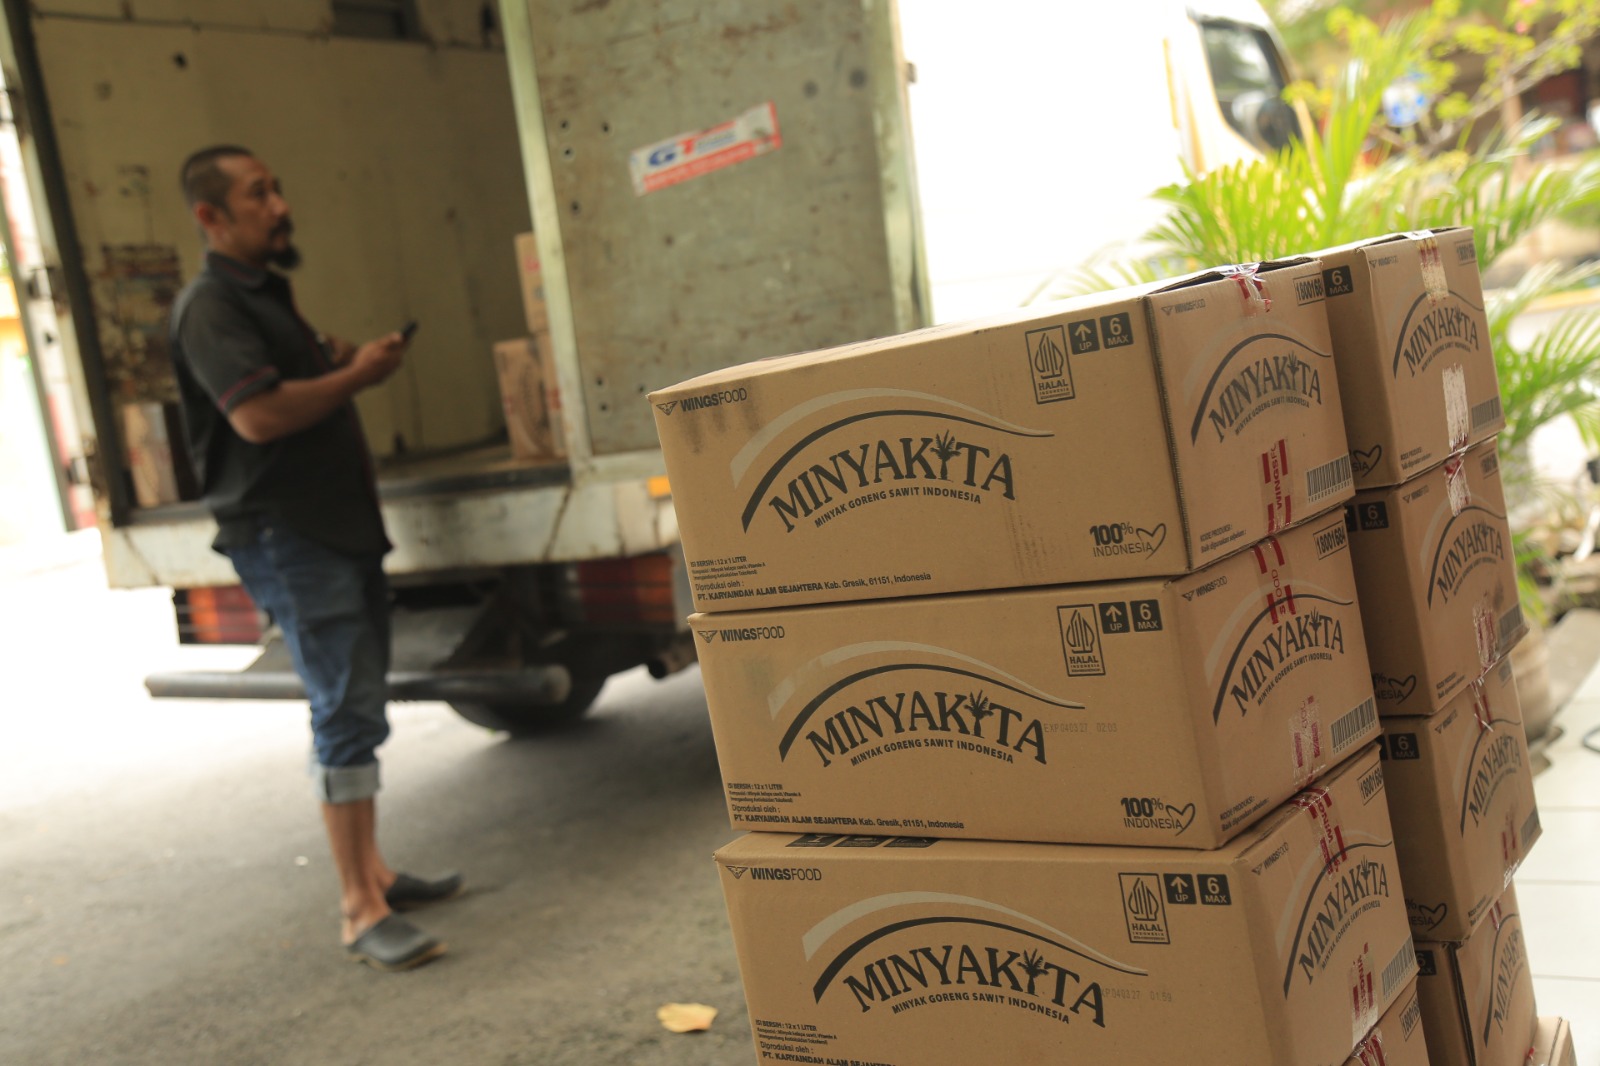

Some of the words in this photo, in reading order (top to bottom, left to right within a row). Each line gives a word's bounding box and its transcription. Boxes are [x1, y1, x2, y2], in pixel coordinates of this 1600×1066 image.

[1331, 270, 1343, 285] 6
[1329, 284, 1350, 294] MAX
[1109, 317, 1122, 336] 6
[1079, 341, 1092, 351] UP
[1107, 334, 1129, 346] MAX
[1038, 379, 1069, 391] HALAL
[680, 387, 747, 412] WINGSFOOD
[769, 430, 1016, 533] MINYAKITA
[814, 503, 848, 528] MINYAK
[848, 491, 887, 510] GORENG
[888, 486, 920, 498] SAWIT
[922, 486, 982, 504] INDONESIA
[1367, 505, 1379, 520] 6
[1364, 519, 1385, 528] MAX
[1089, 521, 1135, 546] 100%
[1093, 542, 1154, 557] INDONESIA
[732, 556, 747, 564] LITER
[695, 581, 726, 592] Diproduksi
[727, 580, 741, 588] oleh
[697, 593, 707, 601] PT.
[708, 588, 755, 600] KARYAINDAH
[756, 586, 777, 596] ALAM
[778, 582, 823, 594] SEJAHTERA
[824, 581, 841, 590] Kab.
[894, 572, 932, 583] Indonesia
[1140, 603, 1151, 620] 6
[1110, 623, 1123, 632] UP
[1137, 621, 1159, 630] MAX
[720, 625, 785, 642] WINGSFOOD
[1069, 655, 1099, 664] HALAL
[1230, 606, 1344, 717] MINYAKITA
[806, 689, 1047, 768] MINYAKITA
[1398, 735, 1409, 751] 6
[850, 747, 883, 767] MINYAK
[884, 739, 922, 753] GORENG
[924, 738, 954, 748] SAWIT
[957, 741, 1014, 764] INDONESIA
[732, 804, 762, 813] Diproduksi
[1121, 797, 1164, 818] 100%
[734, 814, 744, 822] PT.
[745, 814, 790, 824] KARYAINDAH
[791, 816, 813, 824] ALAM
[814, 816, 858, 826] SEJAHTERA
[858, 818, 876, 826] Kab.
[928, 820, 965, 829] Indonesia
[1123, 817, 1183, 829] INDONESIA
[750, 867, 822, 881] WINGSFOOD
[1206, 877, 1220, 894] 6
[1175, 893, 1189, 902] UP
[1205, 894, 1227, 903] MAX
[1299, 854, 1390, 985] MINYAKITA
[1132, 923, 1163, 932] HALAL
[843, 944, 1106, 1028] MINYAKITA
[891, 996, 927, 1015] MINYAK
[928, 992, 970, 1003] GORENG
[972, 992, 1005, 1004] SAWIT
[1008, 997, 1070, 1024] INDONESIA
[760, 1041, 794, 1052] Diproduksi
[796, 1045, 810, 1053] oleh
[762, 1051, 774, 1059] PT.
[775, 1053, 824, 1064] KARYAINDAH
